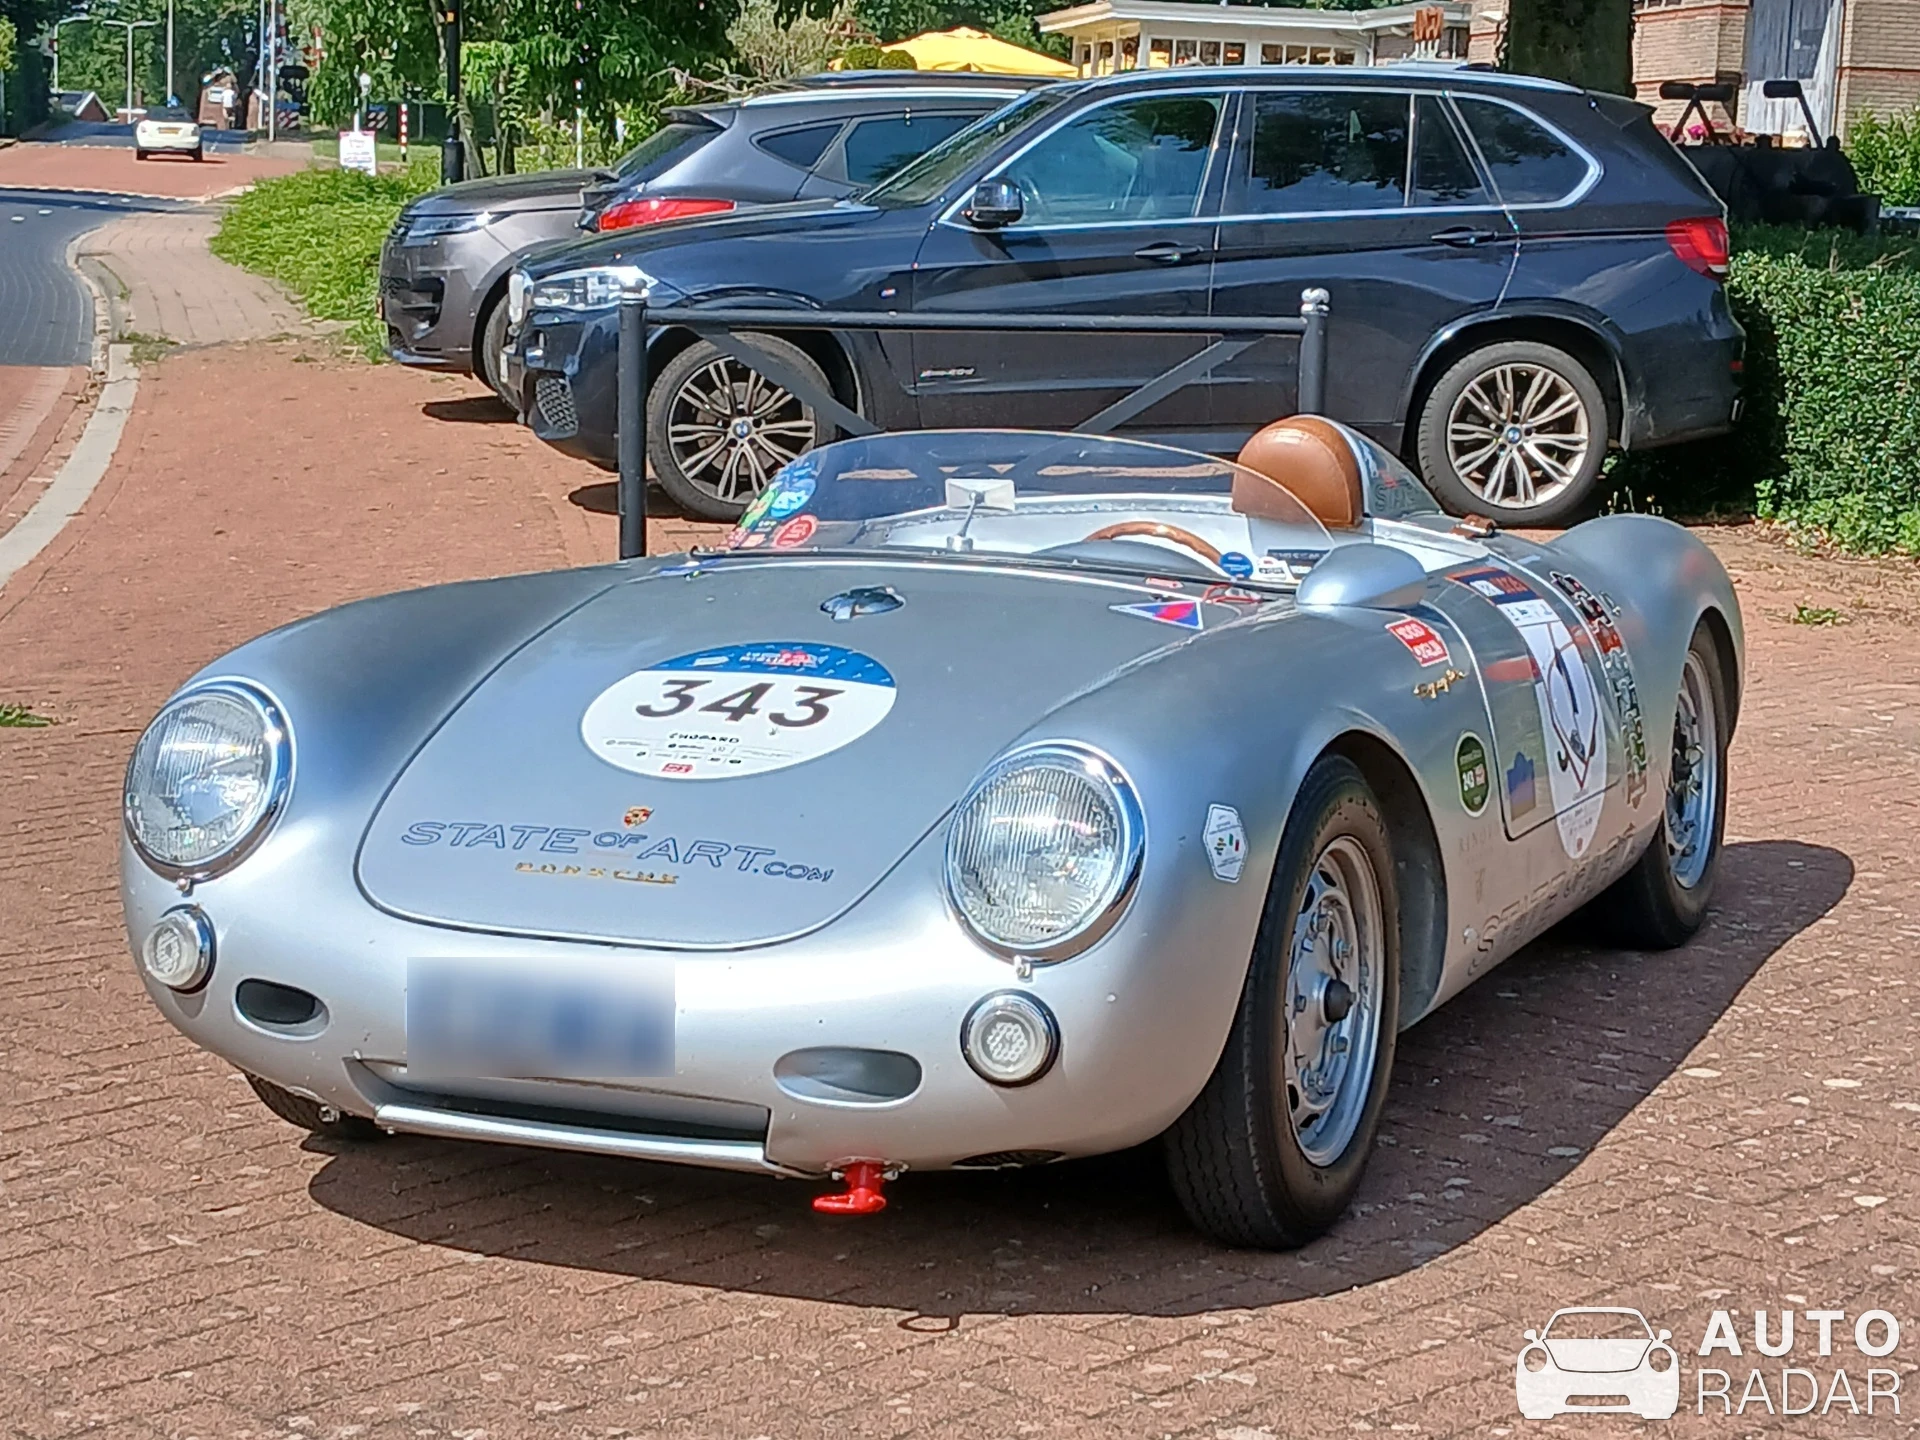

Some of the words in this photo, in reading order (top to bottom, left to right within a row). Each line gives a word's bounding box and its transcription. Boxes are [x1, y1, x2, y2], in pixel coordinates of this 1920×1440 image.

[634, 678, 846, 728] 343
[401, 821, 592, 854] STATE
[593, 831, 649, 849] OF
